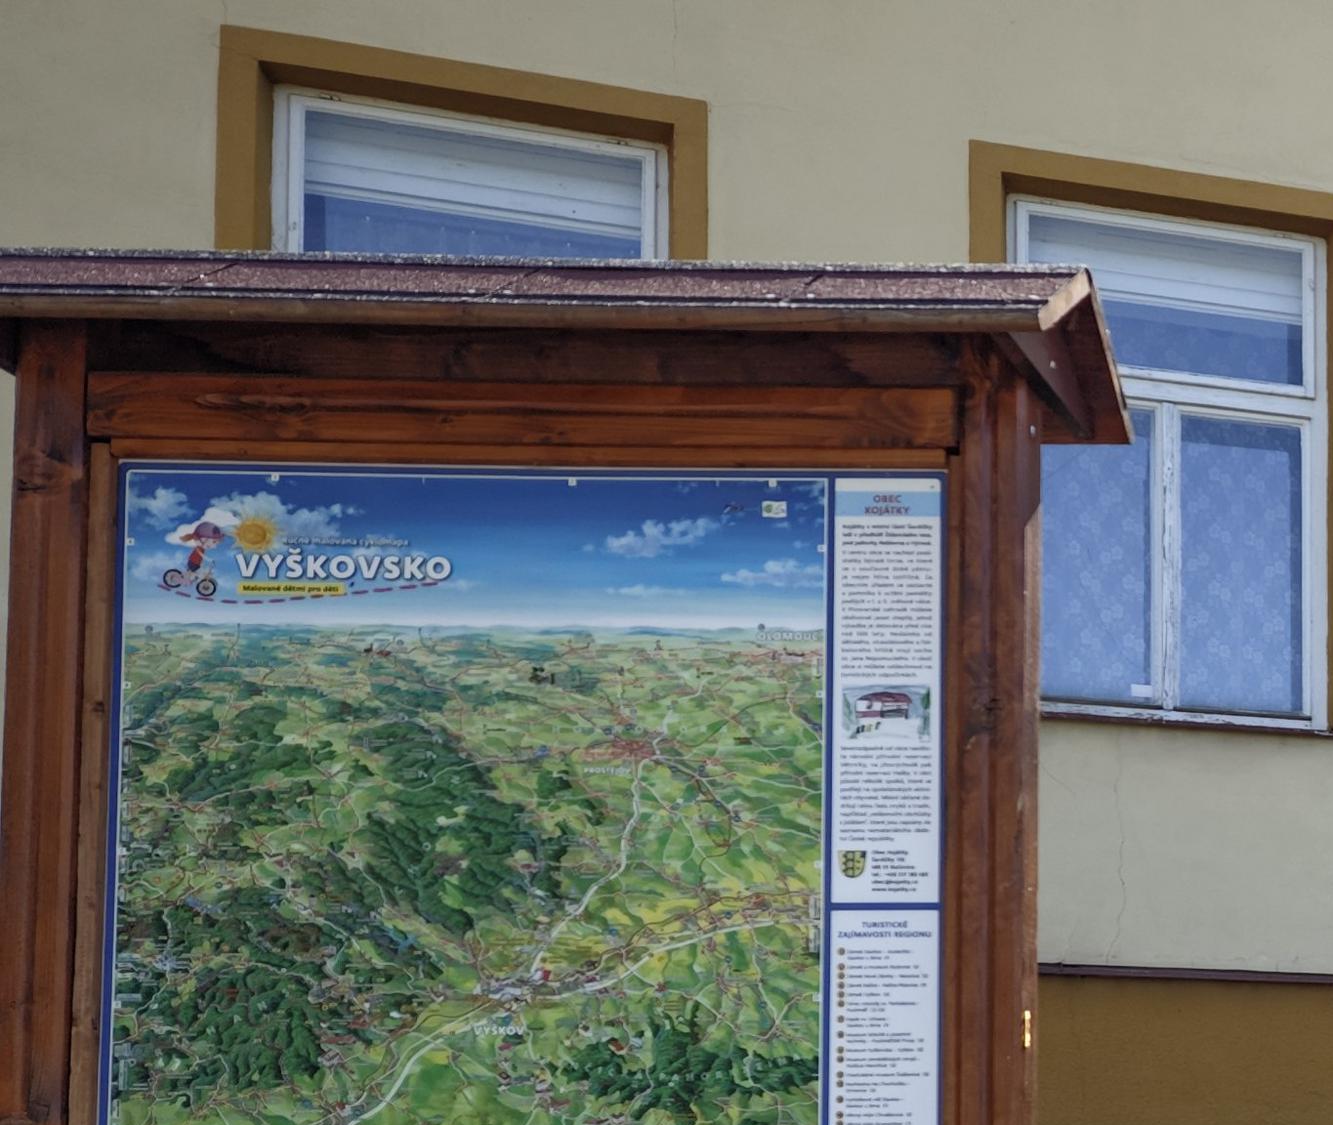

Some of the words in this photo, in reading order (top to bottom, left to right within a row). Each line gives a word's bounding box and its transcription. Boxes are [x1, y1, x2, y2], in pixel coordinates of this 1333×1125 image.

[873, 494, 903, 503] OBEC
[235, 547, 452, 580] VYŠKOVSKO
[861, 920, 908, 929] TURISTICKÉ
[837, 930, 891, 939] ZAJÍMAVOSTI
